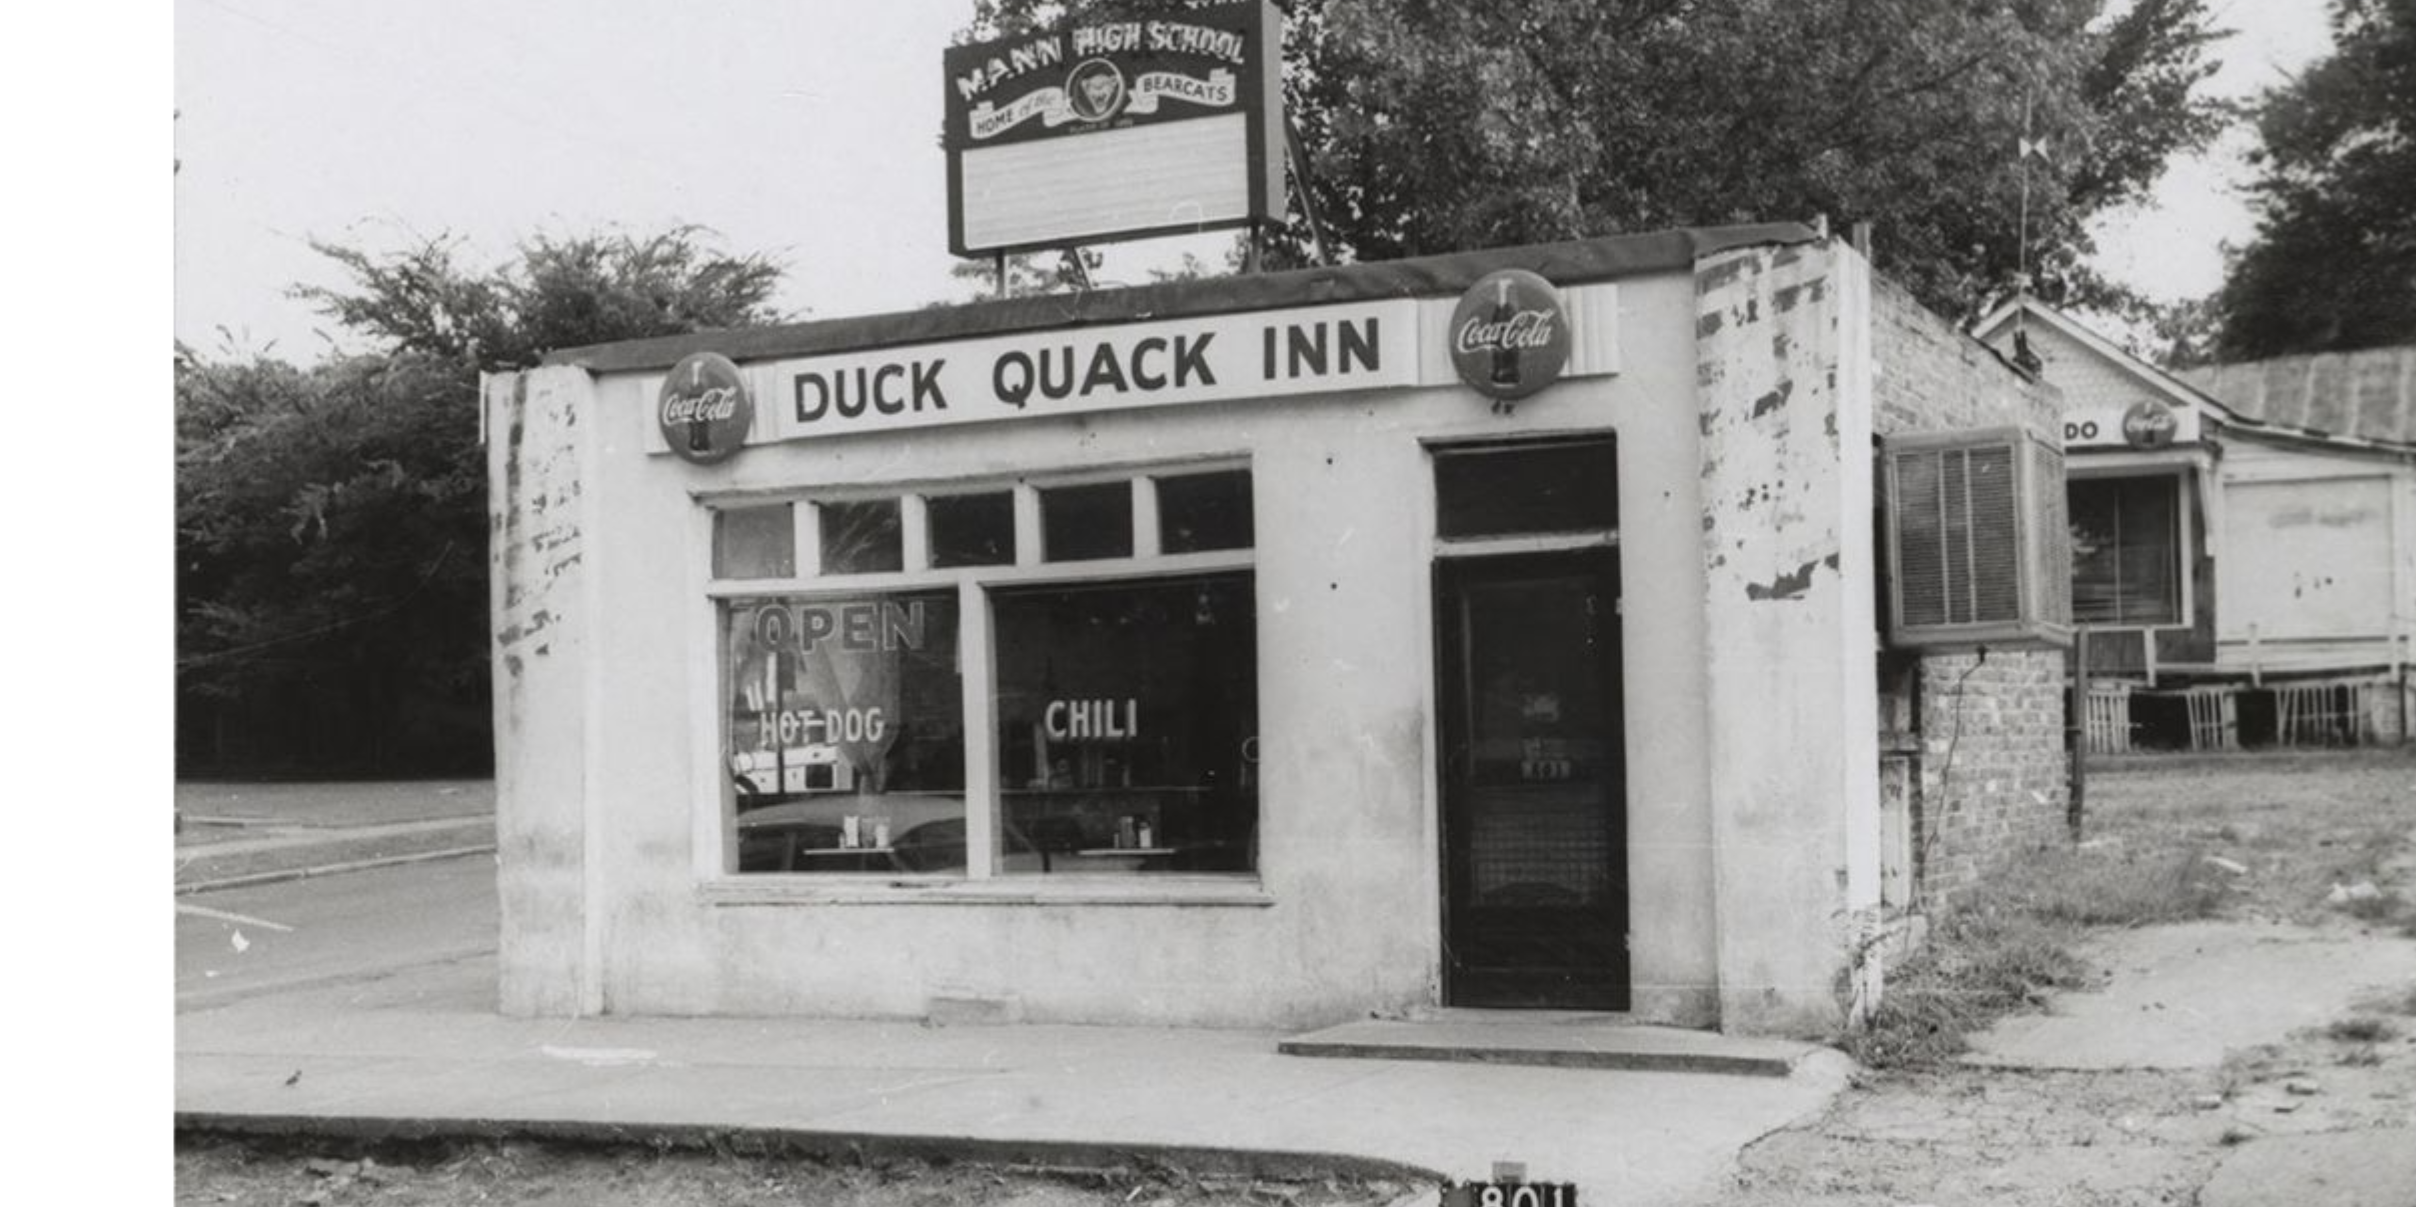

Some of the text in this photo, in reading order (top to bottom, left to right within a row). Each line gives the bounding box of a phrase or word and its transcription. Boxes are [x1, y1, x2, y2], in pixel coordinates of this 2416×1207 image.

[956, 20, 1244, 101] MANN HIGH SCHOOL
[1143, 77, 1228, 102] BEARCATS
[976, 107, 1013, 134] HOME
[1458, 307, 1555, 353] Coca-Cola
[794, 316, 1381, 423] DUCK QUACK INN
[663, 386, 737, 426] Coca-Cola
[756, 600, 925, 654] OPEN
[760, 706, 885, 746] HOT DOG
[1044, 698, 1138, 738] CHILI
